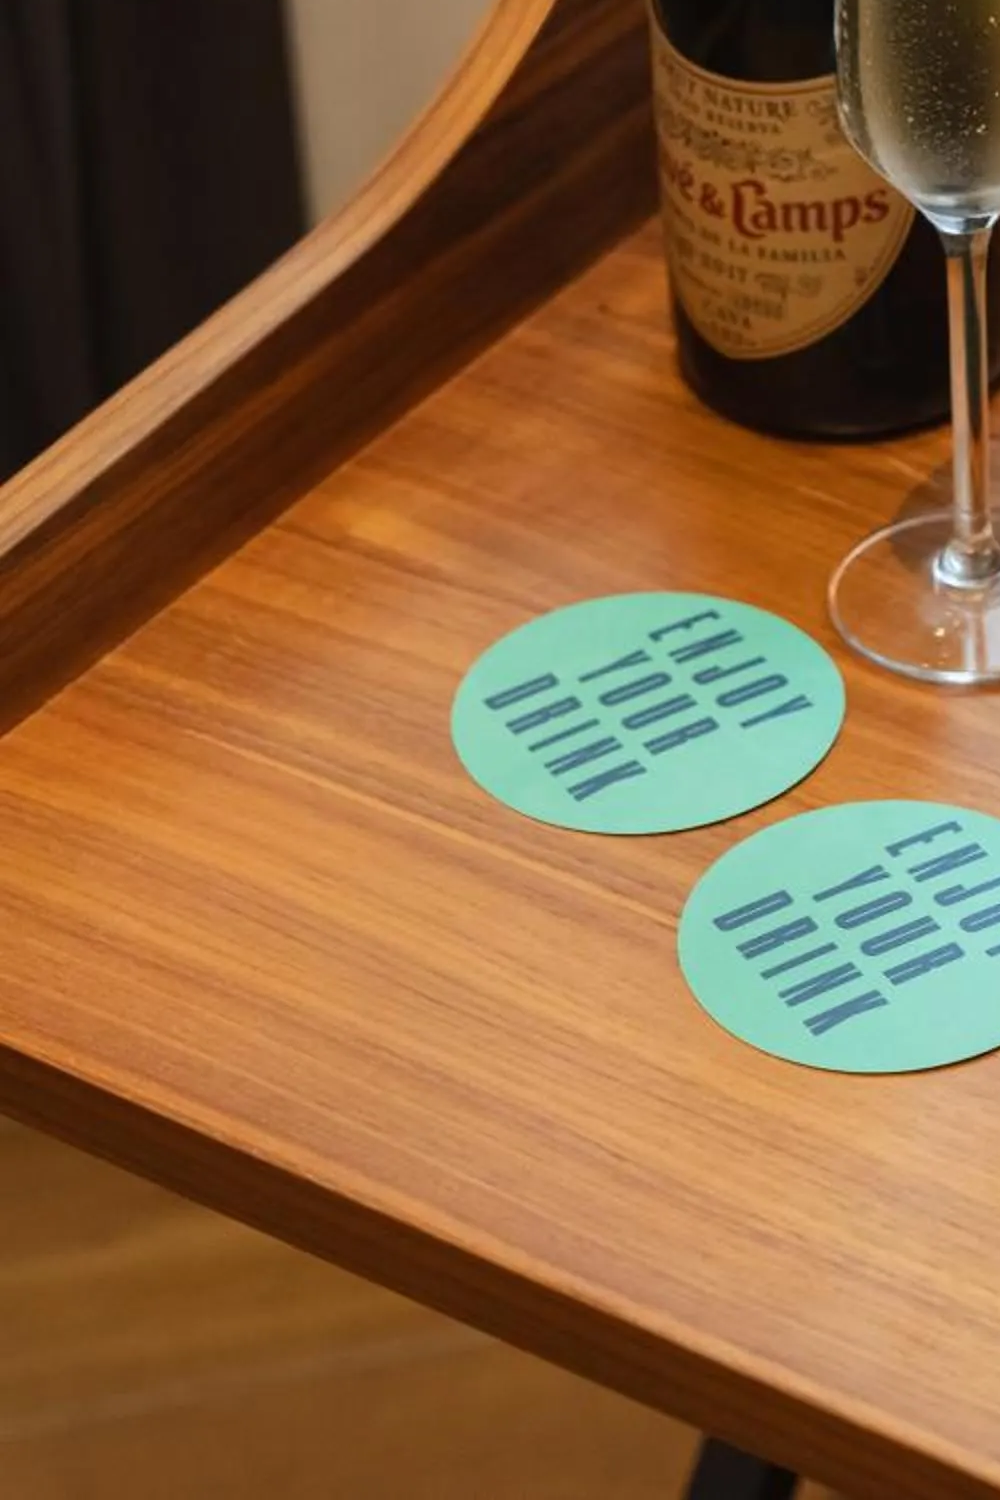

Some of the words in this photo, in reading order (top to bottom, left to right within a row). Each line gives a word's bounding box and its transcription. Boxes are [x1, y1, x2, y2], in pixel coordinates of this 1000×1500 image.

[699, 180, 727, 220] &
[730, 177, 891, 244] Camps
[757, 245, 847, 264] FAMILIA
[578, 649, 720, 756] YOUR
[647, 609, 813, 729] ENJOY
[483, 672, 647, 802] DRINK
[712, 889, 888, 1036] DRINK
[812, 864, 965, 986] YOUR
